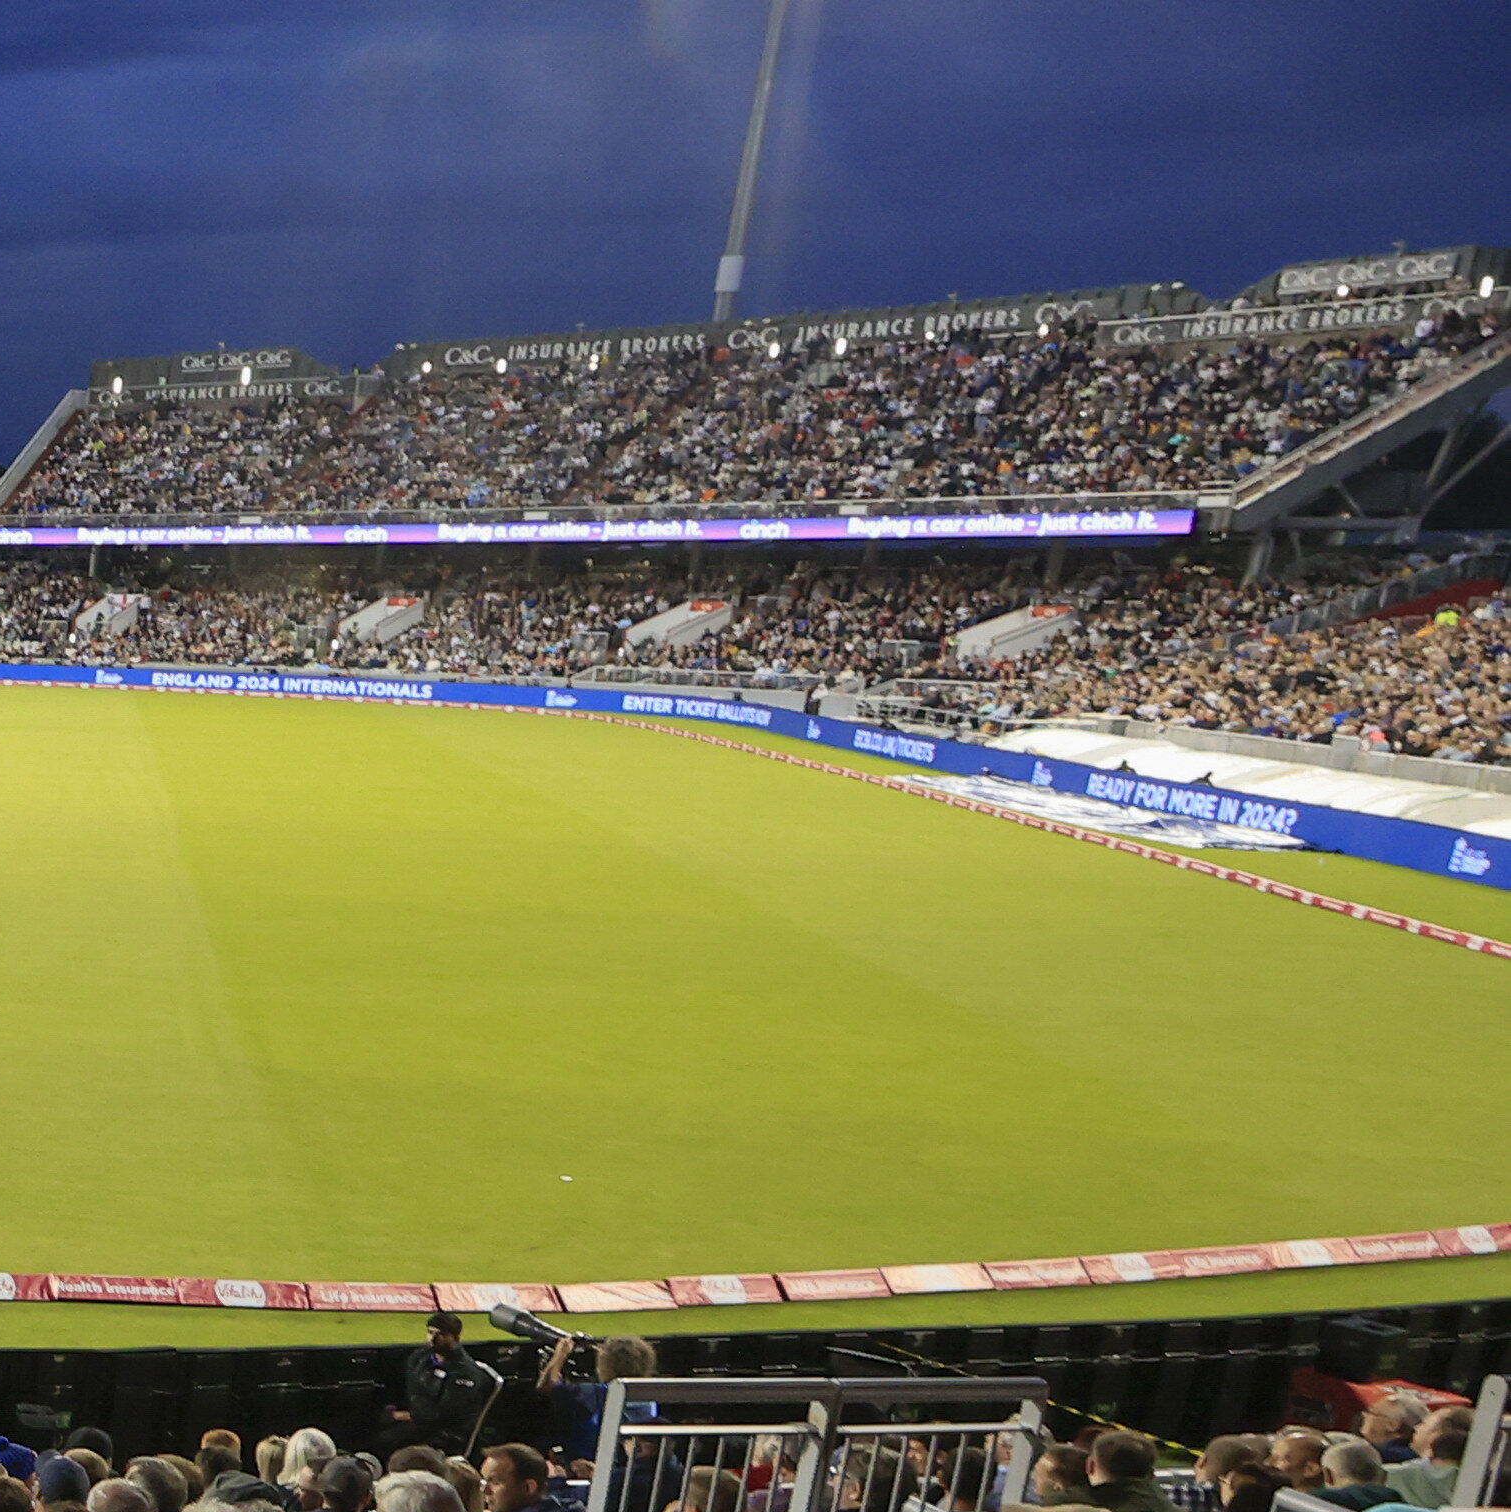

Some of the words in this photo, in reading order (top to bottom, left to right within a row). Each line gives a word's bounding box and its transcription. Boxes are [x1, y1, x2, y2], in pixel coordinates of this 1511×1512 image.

[1183, 313, 1299, 337] INSURANCE
[1308, 302, 1405, 327] BROKERS
[77, 527, 126, 544] Buying
[141, 530, 167, 541] car
[168, 528, 213, 541] online
[223, 527, 252, 543] just
[253, 527, 295, 541] cinch
[344, 526, 387, 542] cinch
[438, 523, 493, 542] Buying
[509, 526, 537, 538] car
[539, 523, 590, 537] online
[602, 522, 635, 541] just
[637, 520, 682, 537] cinch
[739, 520, 789, 539] cinch
[847, 517, 908, 538] Buying
[912, 521, 927, 534] a
[930, 520, 963, 534] car
[965, 515, 1025, 533] online
[1036, 514, 1077, 537] just
[1079, 512, 1132, 532] cinch
[151, 672, 233, 688] ENGLAND
[237, 675, 279, 692] 2024
[283, 678, 433, 699] INTERNATIONALS
[622, 694, 673, 714] ENTER
[675, 698, 717, 719] TICKET
[852, 728, 936, 763] ECB.CO.UK/TICKETS
[1086, 773, 1135, 803] READY
[1133, 780, 1168, 810] FOR
[1165, 786, 1218, 819] MORE
[1217, 797, 1240, 823] IN
[1238, 801, 1298, 834] 2024?
[105, 1283, 176, 1296] insurance
